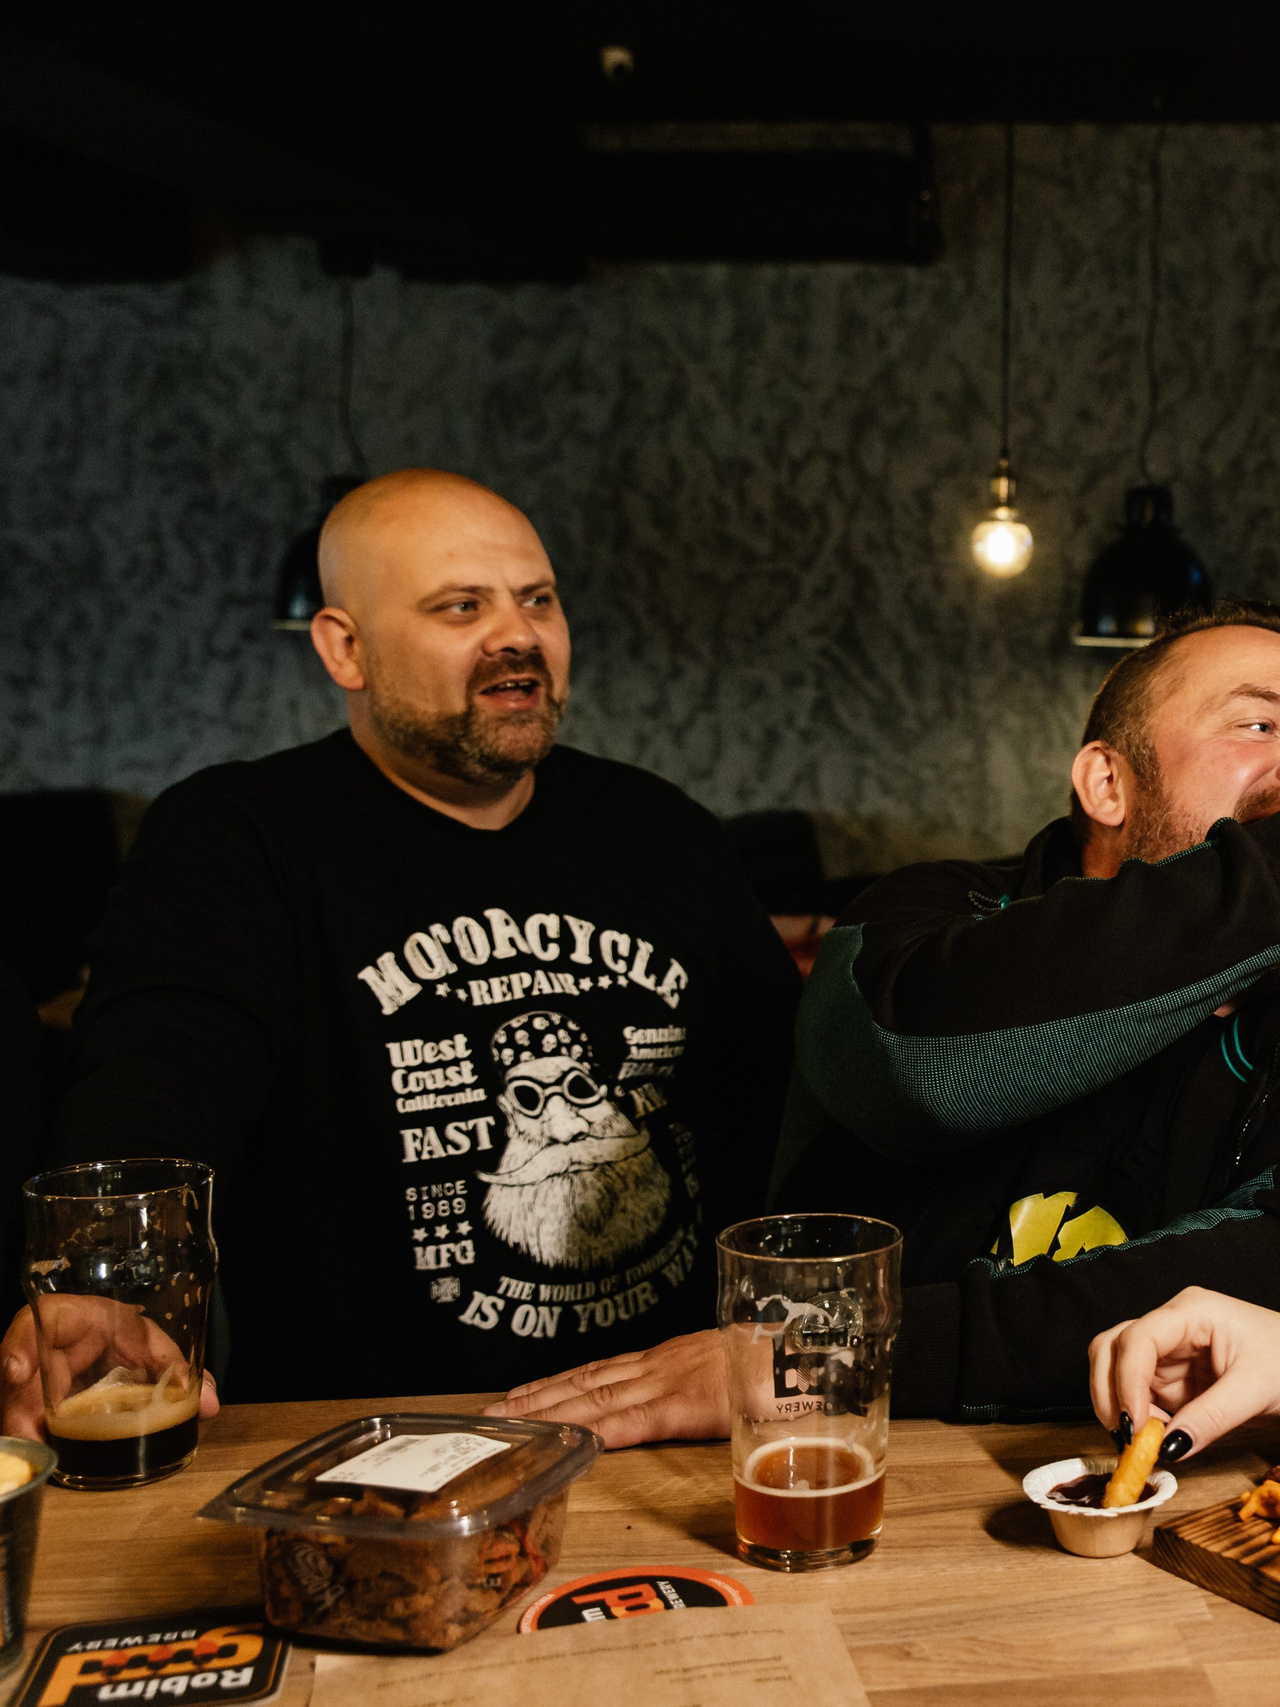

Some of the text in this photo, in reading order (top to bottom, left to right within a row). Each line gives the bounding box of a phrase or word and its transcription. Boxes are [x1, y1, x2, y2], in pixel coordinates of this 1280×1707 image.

[467, 970, 580, 1006] REPAIR
[385, 1033, 473, 1068] West
[391, 1060, 479, 1095] Coast
[399, 1115, 496, 1163] FAST
[405, 1180, 468, 1202] SINCE
[407, 1197, 466, 1221] 1989
[413, 1239, 476, 1271] MFG
[496, 1275, 537, 1301] THE
[538, 1280, 597, 1304] WORLD
[457, 1290, 506, 1331] IS
[510, 1303, 563, 1340] ON
[572, 1280, 660, 1334] YOUR
[66, 1628, 197, 1655] BREWERY
[97, 1666, 255, 1701] Robim
